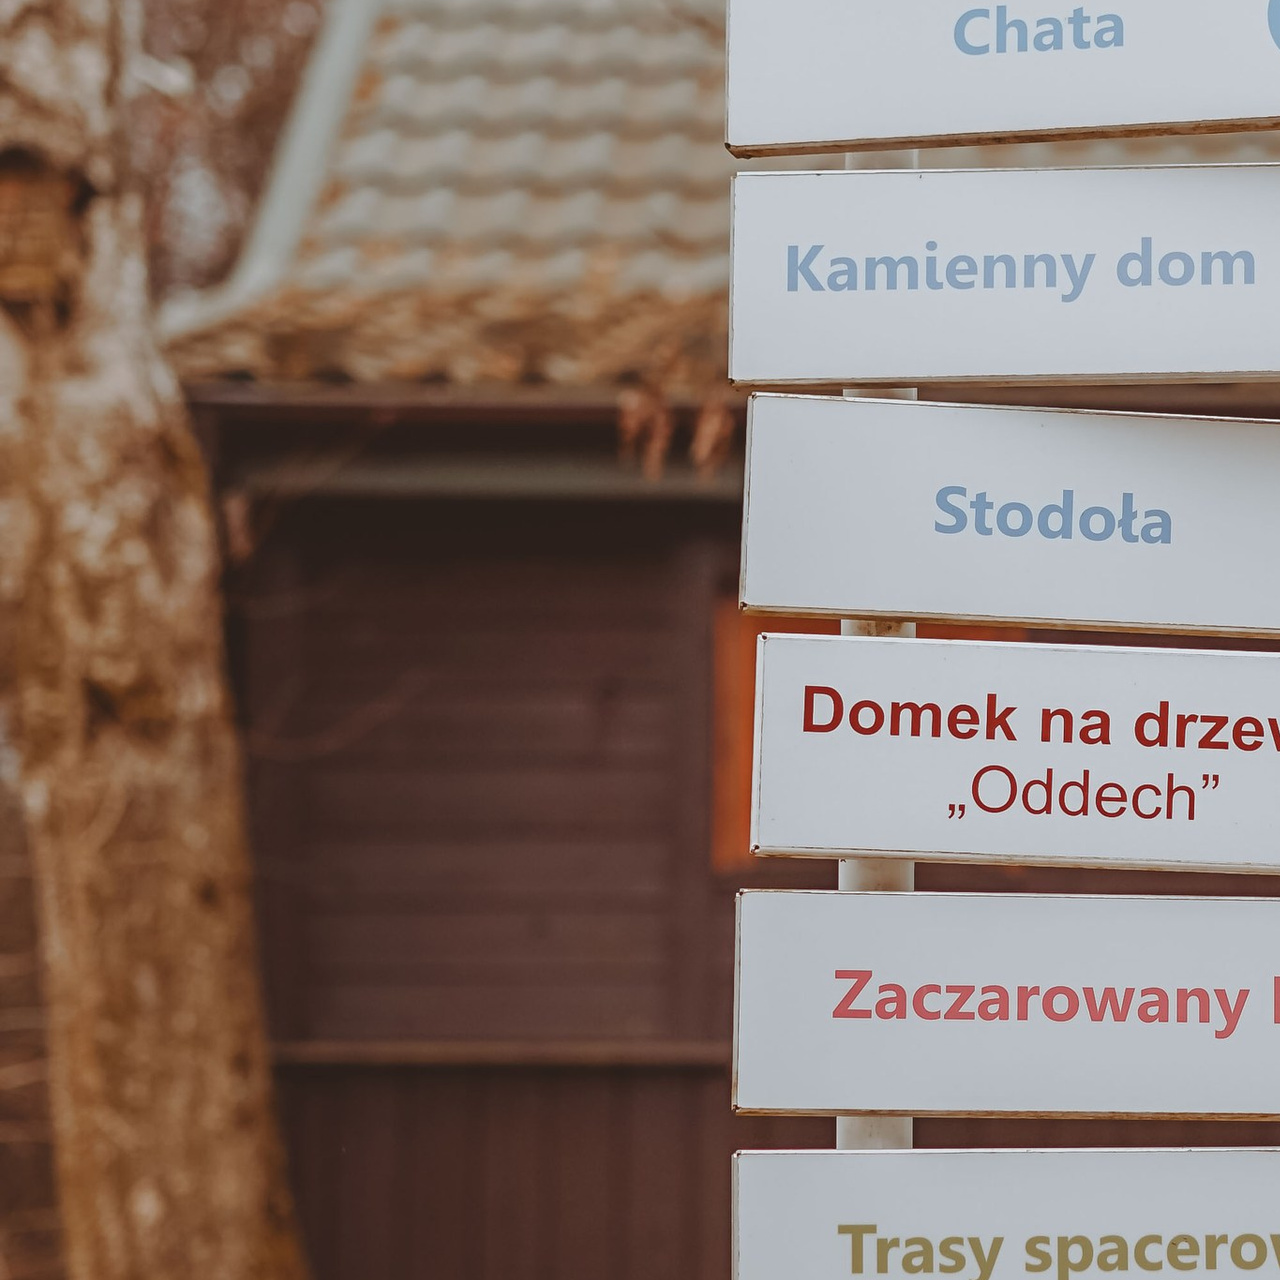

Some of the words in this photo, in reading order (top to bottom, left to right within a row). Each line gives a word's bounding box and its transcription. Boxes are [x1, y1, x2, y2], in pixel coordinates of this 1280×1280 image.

[953, 5, 1125, 56] Chata
[787, 240, 1096, 303] Kamienny
[1116, 237, 1256, 287] dom
[934, 485, 1173, 544] Stodoła
[802, 684, 1018, 742] Domek
[1040, 707, 1112, 746] na
[832, 969, 1251, 1040] Zaczarowany
